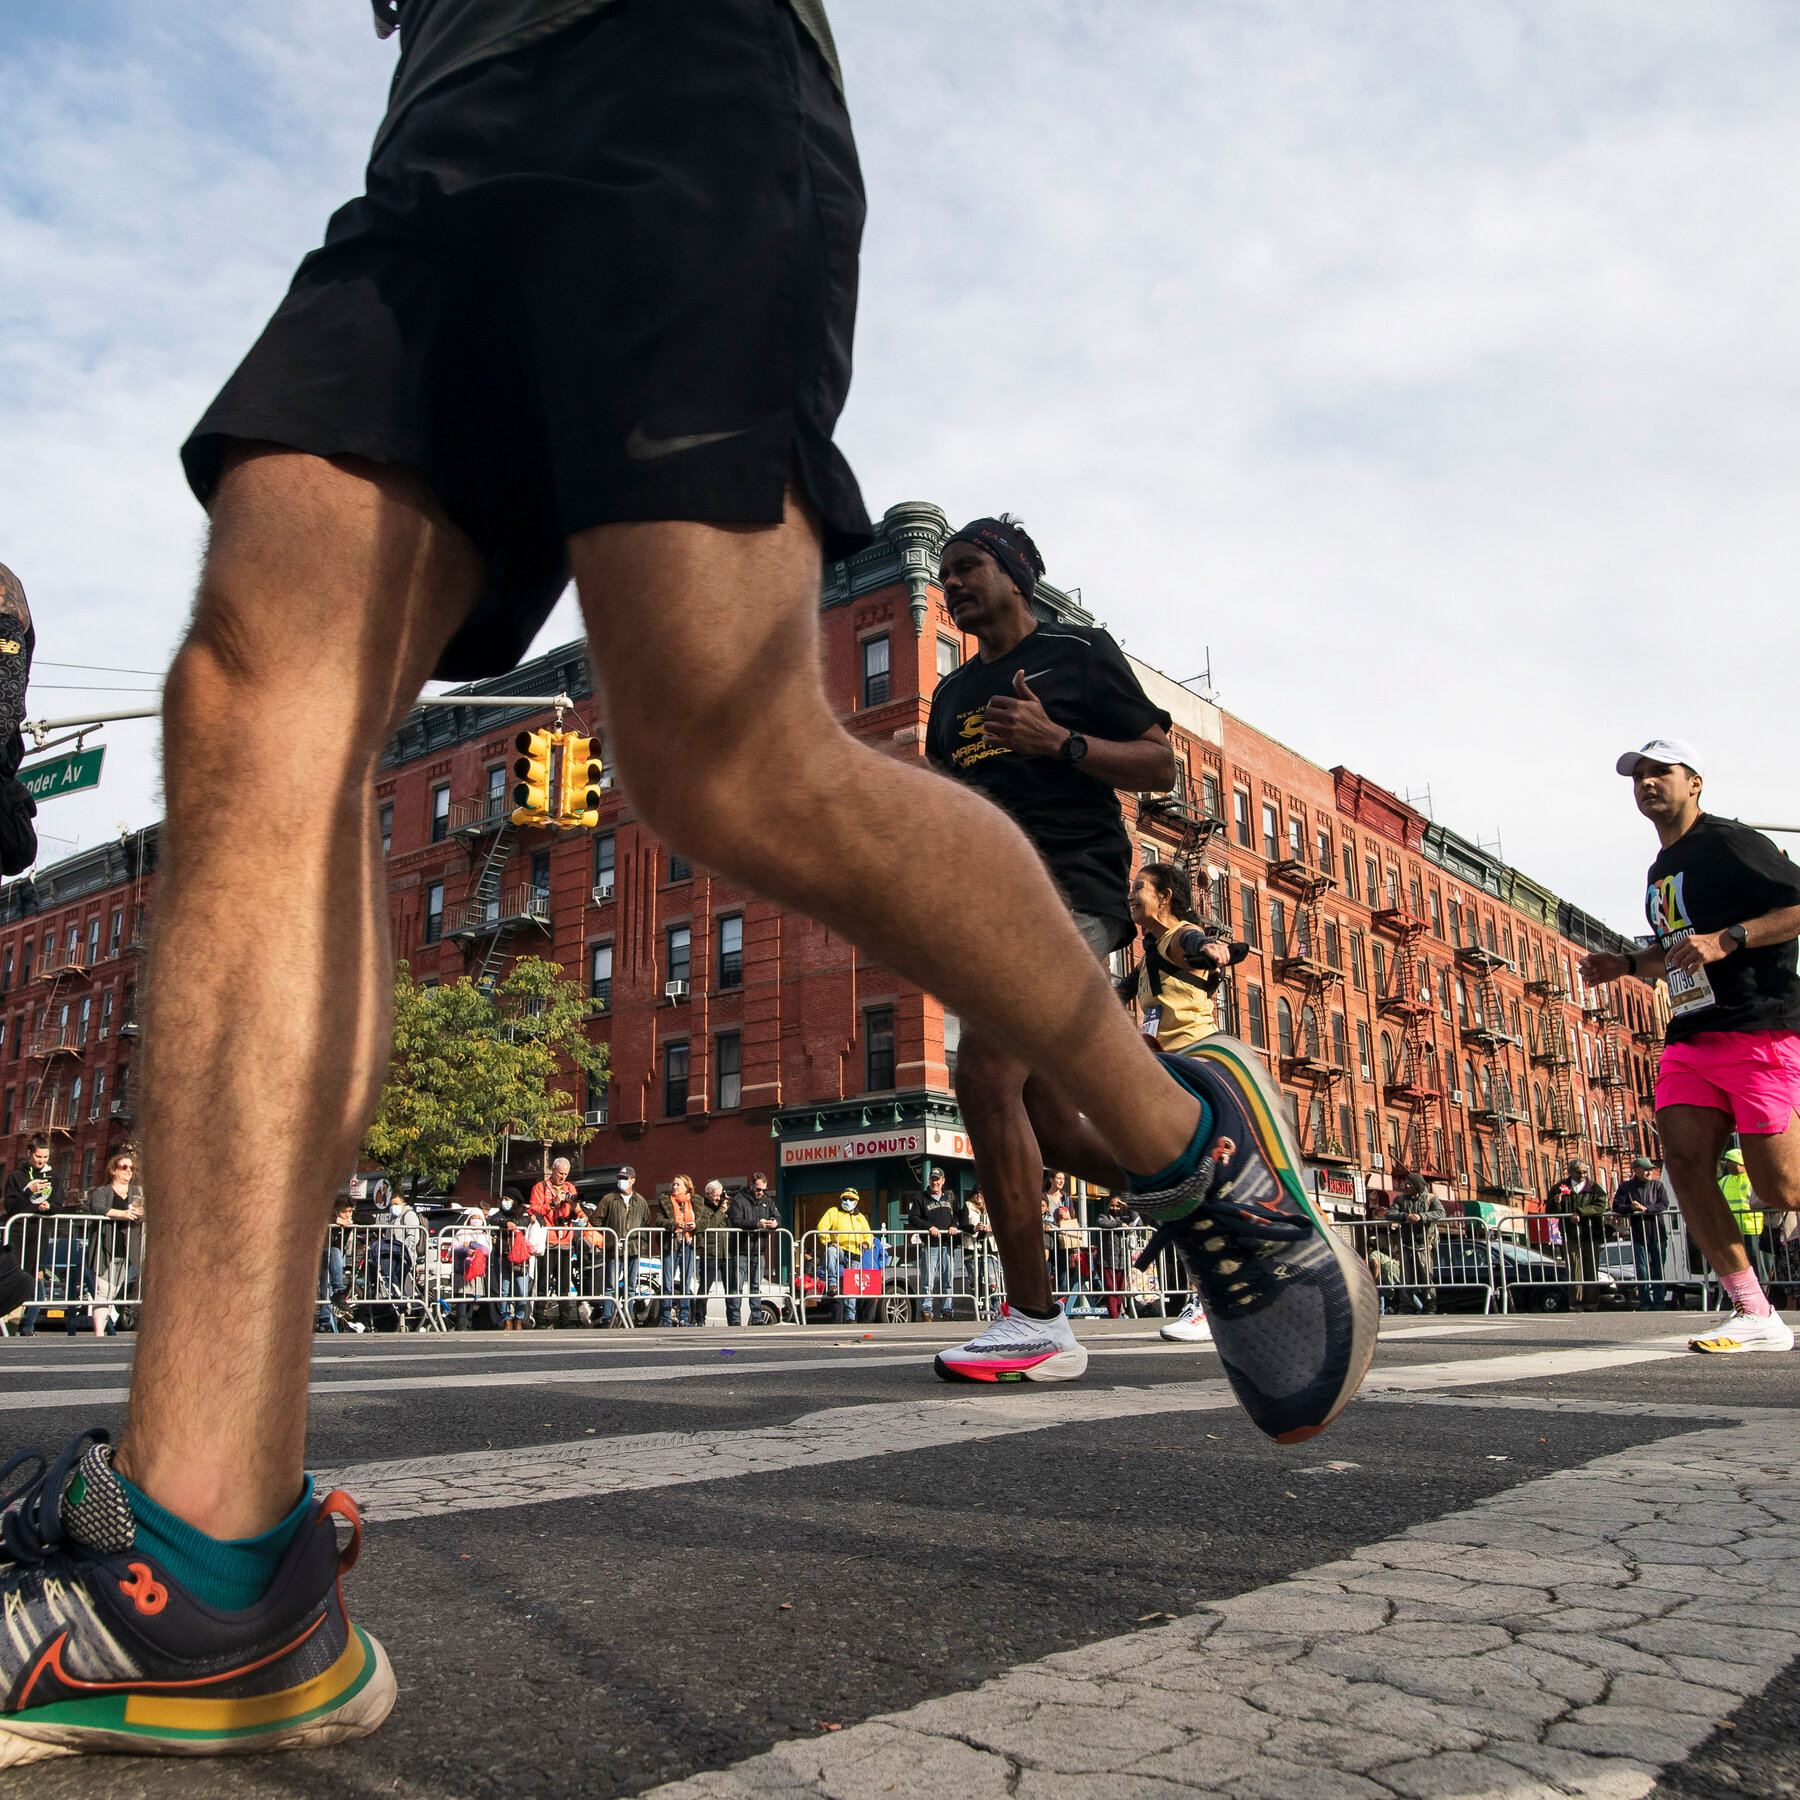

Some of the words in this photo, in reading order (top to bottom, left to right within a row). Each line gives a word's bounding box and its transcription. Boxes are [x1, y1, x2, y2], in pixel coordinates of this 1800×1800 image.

[952, 741, 987, 762] MARA
[26, 773, 57, 794] nder
[61, 764, 83, 786] Av
[785, 1144, 842, 1163] DUNKIN'
[856, 1136, 917, 1156] DONUTS
[1329, 1180, 1354, 1195] RIGHTS
